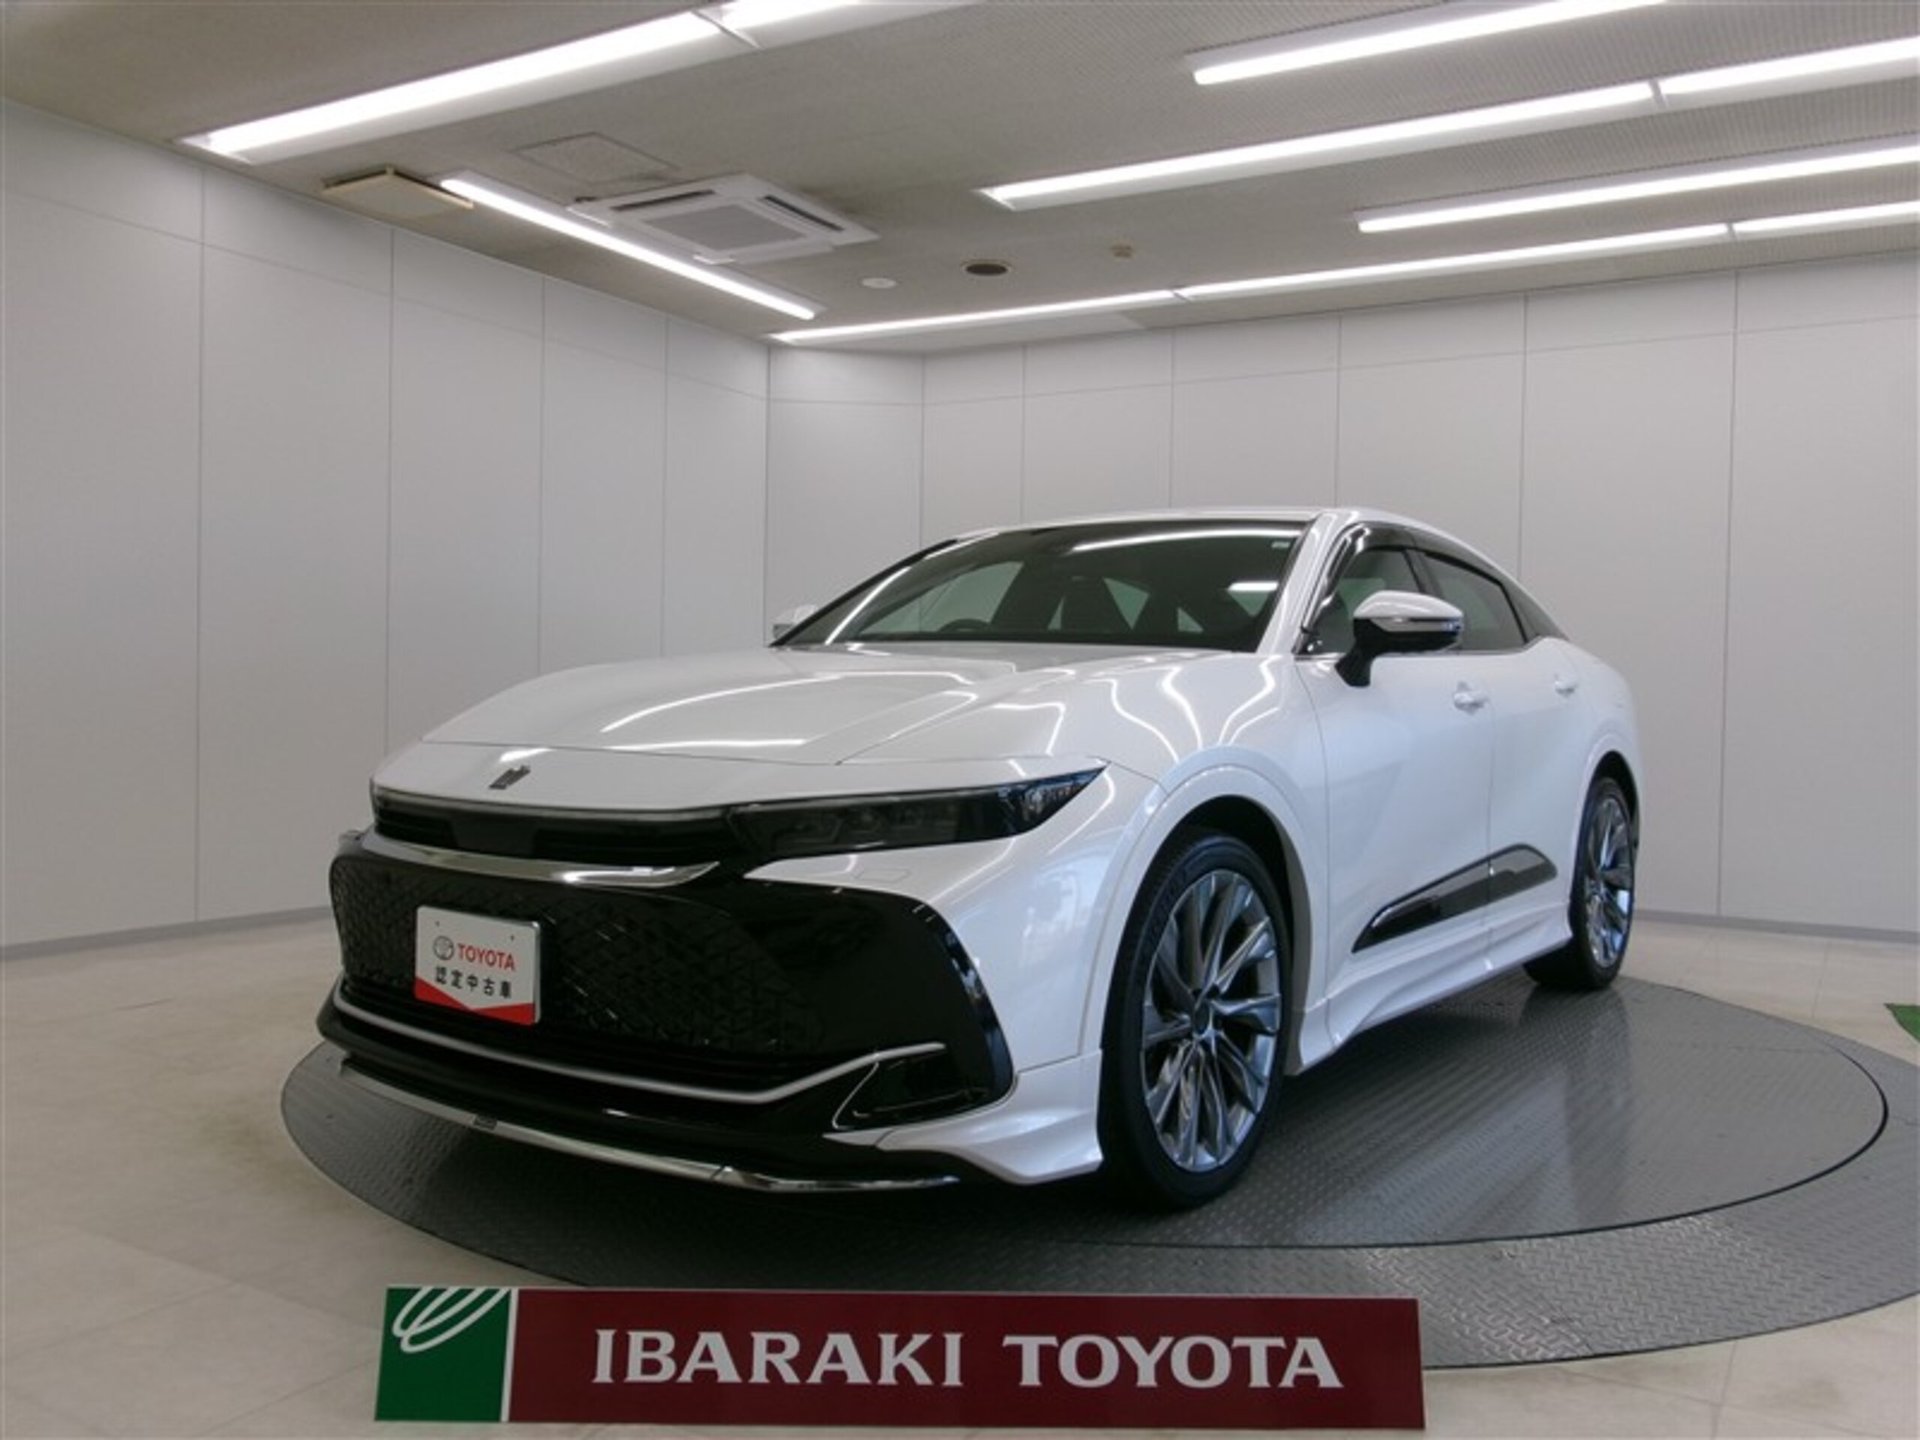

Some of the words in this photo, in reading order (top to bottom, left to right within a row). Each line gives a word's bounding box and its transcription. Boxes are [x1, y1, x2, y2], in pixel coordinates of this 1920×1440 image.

[457, 943, 515, 971] TOYOTA
[435, 965, 512, 998] 認定中古車
[593, 1329, 963, 1386] IBARAKI
[1002, 1334, 1343, 1389] TOYOTA
